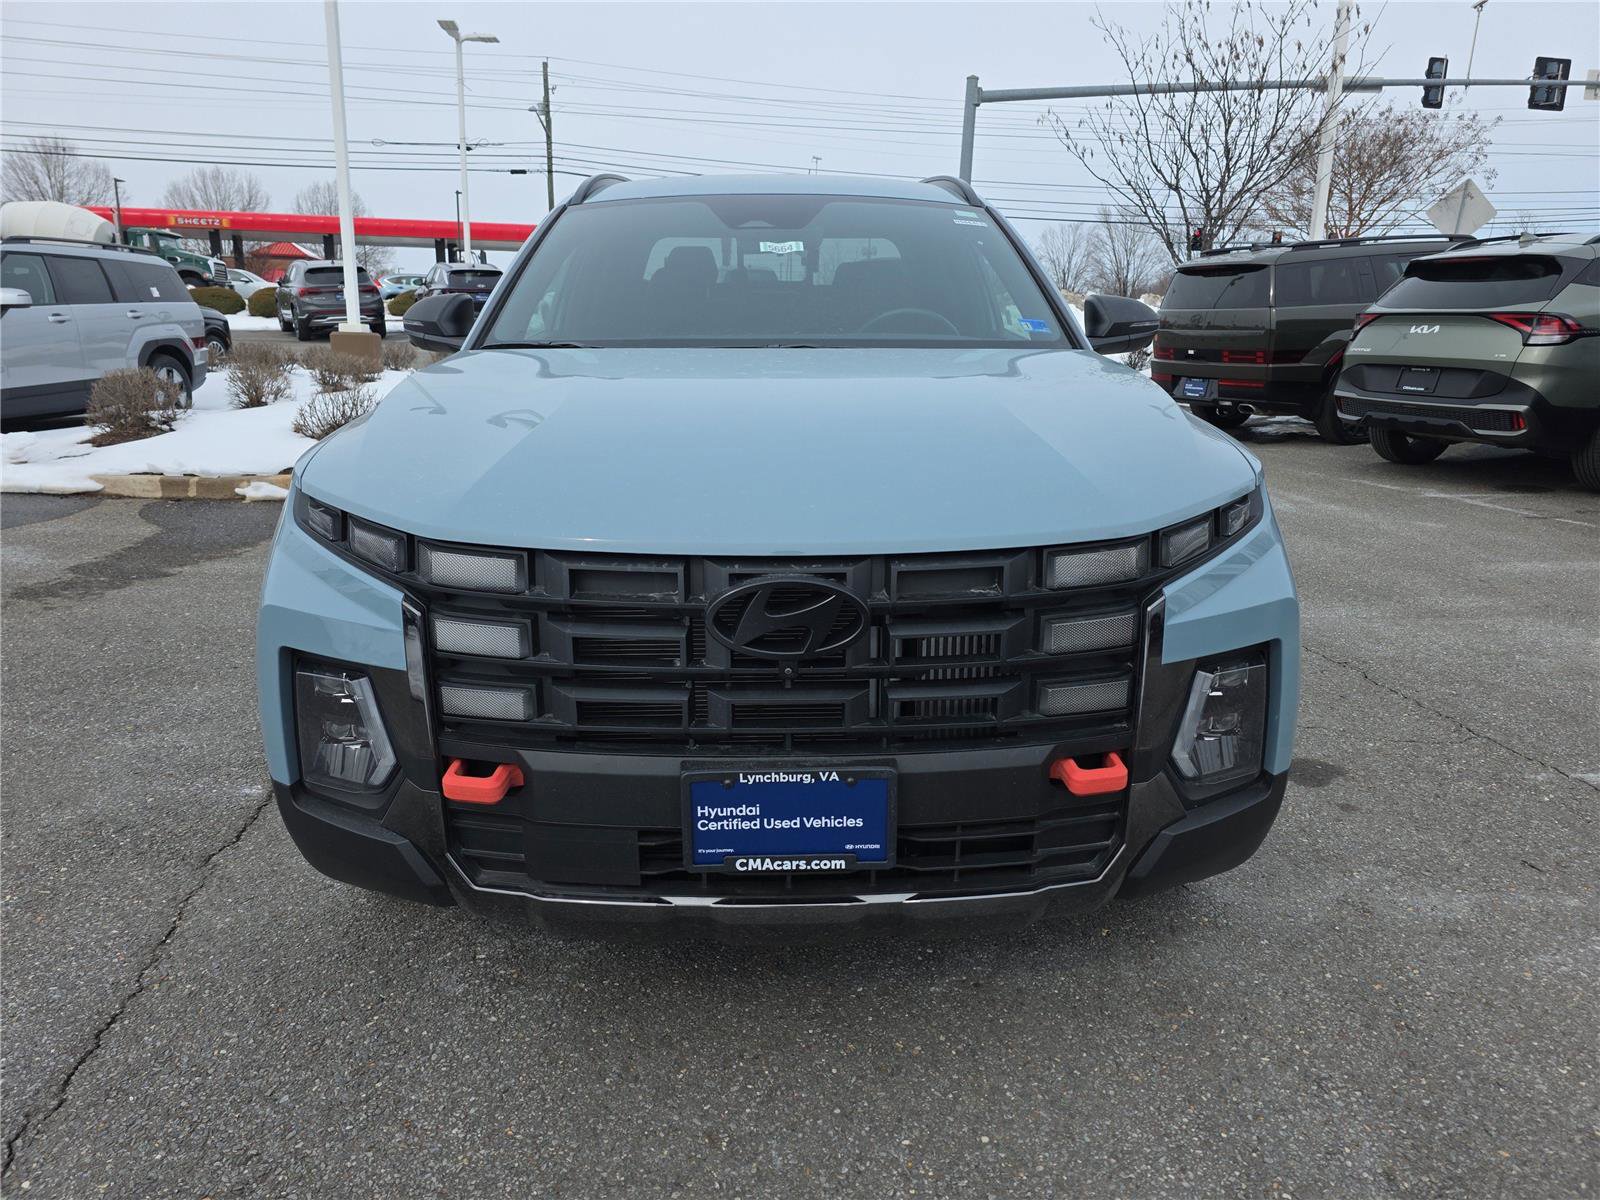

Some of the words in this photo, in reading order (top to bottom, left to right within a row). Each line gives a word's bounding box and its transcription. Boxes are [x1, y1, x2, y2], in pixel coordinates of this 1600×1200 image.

[177, 217, 220, 226] SHEETZ
[1409, 324, 1440, 334] KIA
[739, 772, 815, 784] Lynchburg,
[819, 771, 840, 782] VA
[697, 804, 760, 819] Hyundai
[697, 818, 760, 831] Certified
[763, 817, 800, 829] Used
[803, 816, 864, 828] Vehicles
[735, 857, 846, 871] CMAcars.com
